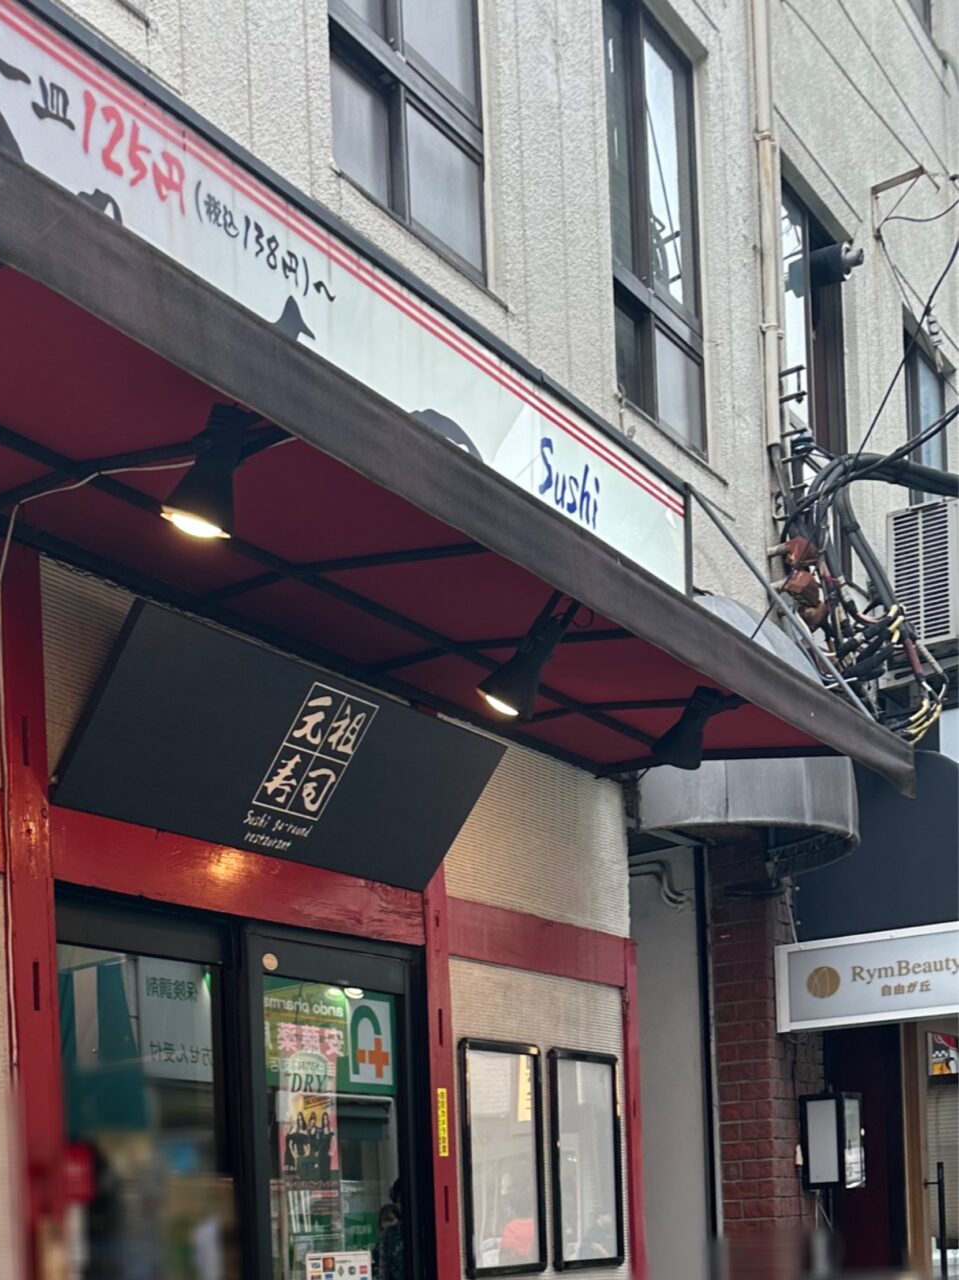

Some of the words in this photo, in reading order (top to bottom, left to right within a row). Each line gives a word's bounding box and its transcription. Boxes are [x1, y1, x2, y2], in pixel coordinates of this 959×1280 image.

[538, 436, 601, 530] Sushi
[292, 695, 367, 755] 元祖
[263, 753, 337, 813] 寿司
[243, 809, 270, 829] Sushi
[243, 830, 292, 852] restaurant
